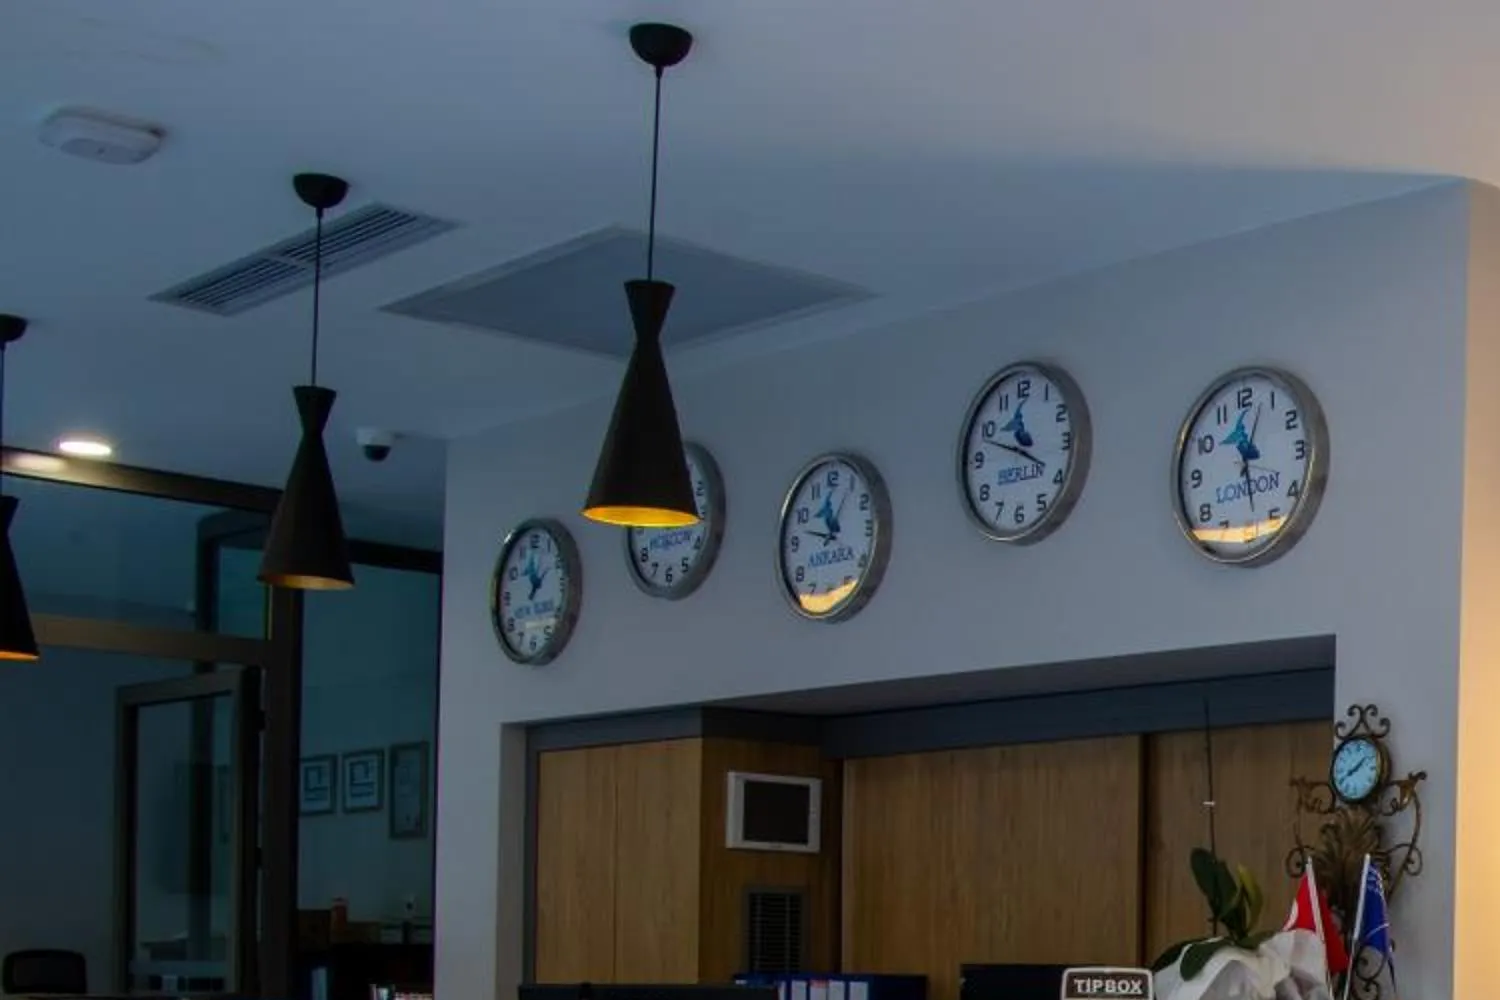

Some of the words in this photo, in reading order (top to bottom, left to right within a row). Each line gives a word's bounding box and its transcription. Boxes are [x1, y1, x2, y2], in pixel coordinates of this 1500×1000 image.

[1017, 380, 1031, 398] 12
[1237, 388, 1253, 408] 12
[1000, 394, 1009, 413] 11
[1055, 404, 1067, 422] 2
[1217, 407, 1227, 425] 11
[1286, 410, 1297, 430] 2
[982, 420, 996, 438] 10
[1062, 432, 1071, 450] 3
[1198, 435, 1214, 455] 10
[1295, 440, 1305, 460] 3
[974, 452, 985, 469] 9
[827, 471, 839, 487] 12
[997, 463, 1045, 486] BERLIN
[1053, 469, 1063, 484] 4
[1191, 469, 1202, 488] 9
[812, 484, 821, 500] 11
[979, 484, 990, 501] 8
[1216, 472, 1280, 503] LONDON
[1287, 480, 1299, 498] 4
[860, 493, 869, 511] 2
[1036, 493, 1047, 512] 5
[797, 508, 809, 524] 10
[995, 502, 1005, 521] 7
[1014, 504, 1025, 524] 6
[1200, 504, 1212, 522] 8
[791, 536, 799, 552] 9
[641, 548, 648, 562] 8
[808, 547, 854, 568] ANKARA
[652, 562, 659, 577] 7
[665, 567, 672, 582] 6
[682, 558, 689, 573] 5
[796, 566, 805, 582] 8
